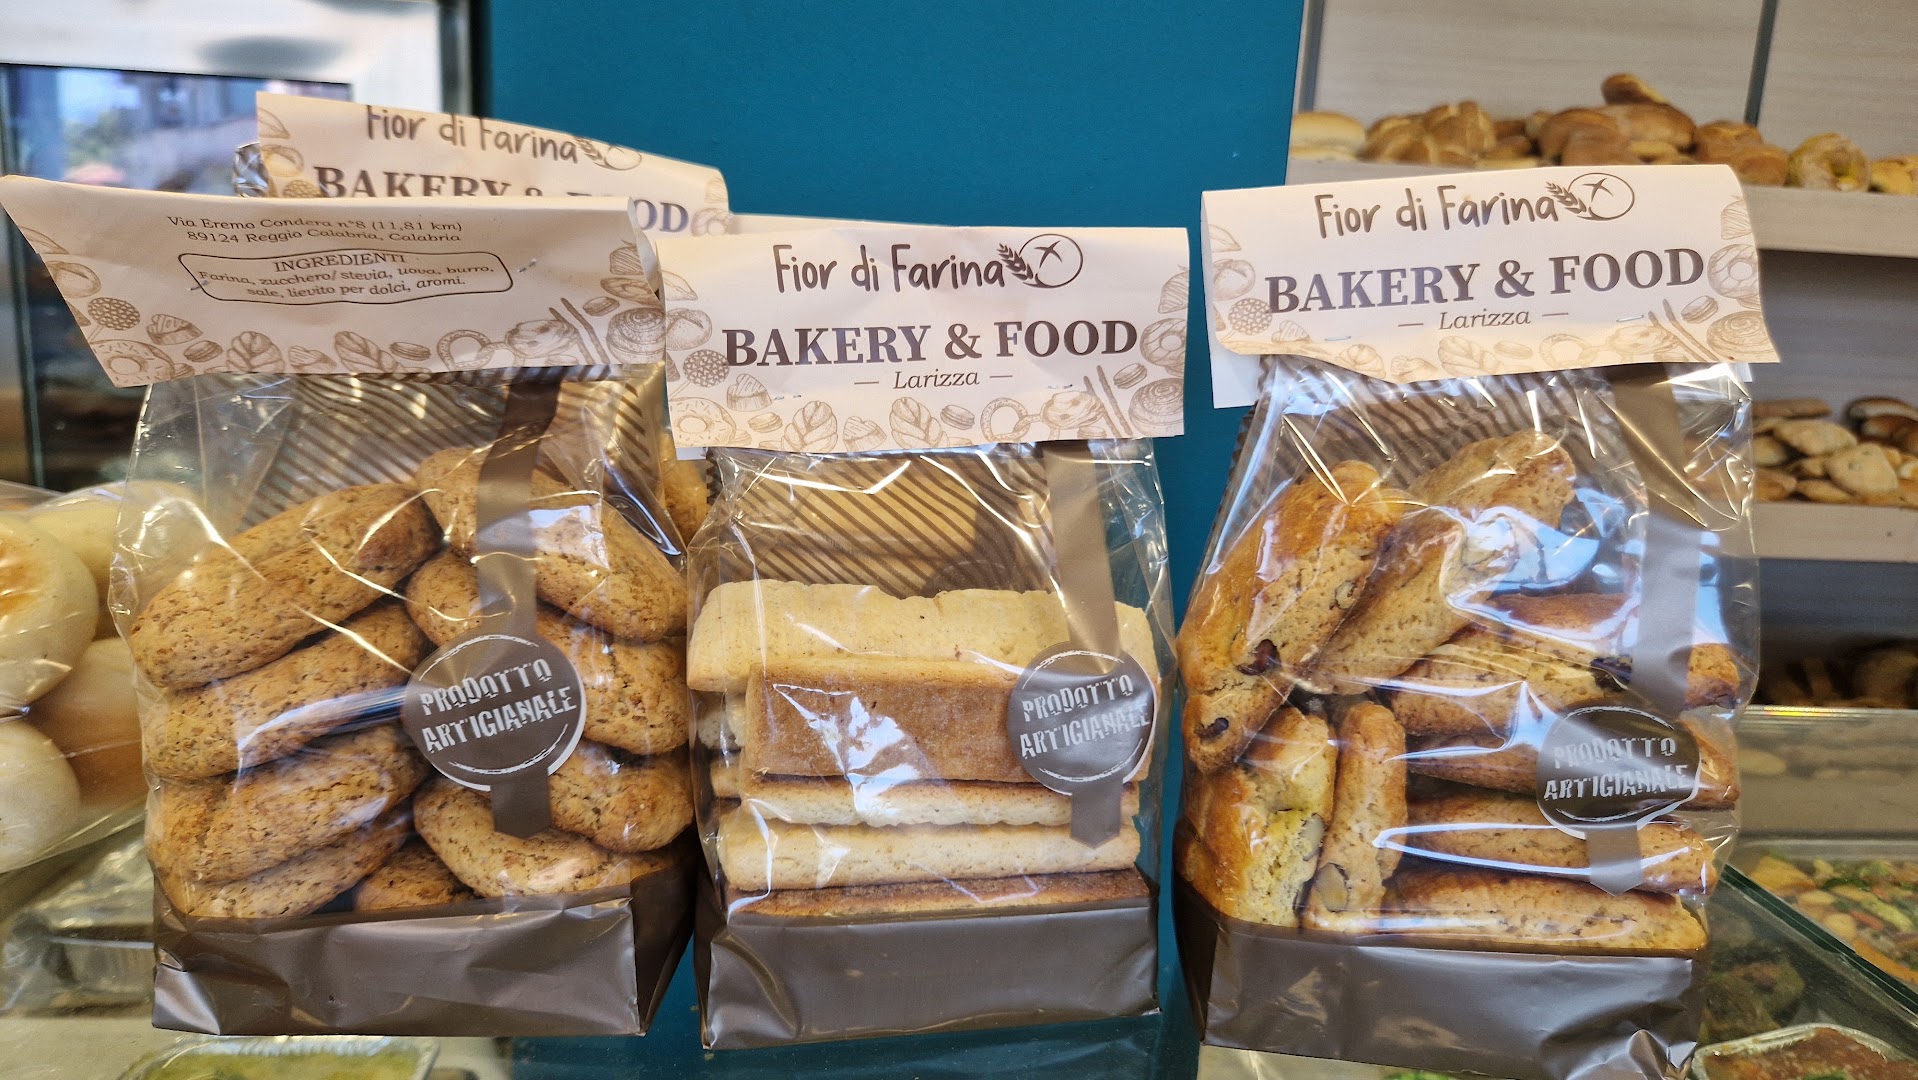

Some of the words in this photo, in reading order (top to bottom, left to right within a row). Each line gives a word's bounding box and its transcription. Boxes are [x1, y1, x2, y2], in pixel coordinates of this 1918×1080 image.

[367, 105, 426, 140] Fior
[439, 109, 466, 147] di
[478, 116, 578, 164] Farina
[168, 216, 195, 228] Via
[201, 218, 256, 229] Eremo
[260, 217, 333, 229] Condera
[337, 220, 366, 230] n°8
[372, 221, 423, 232] (11,81
[431, 222, 462, 232] km)
[1315, 193, 1381, 239] Fior
[1395, 186, 1428, 232] di
[1440, 184, 1559, 231] Farina
[187, 231, 239, 243] 89124
[246, 230, 302, 243] Reggio
[308, 228, 384, 241] Calabria,
[389, 233, 461, 242] Calabria
[199, 271, 256, 286] Farina,
[259, 269, 337, 286] zucchero/
[341, 269, 392, 281] stevia,
[399, 267, 441, 276] uova,
[447, 266, 494, 275] burro,
[274, 253, 406, 273] INGREDIENTI
[773, 244, 837, 294] Fior
[851, 243, 880, 292] di
[892, 244, 1006, 291] Farina
[1264, 262, 1482, 314] BAKERY
[1494, 258, 1535, 298] &
[1549, 247, 1705, 294] FOOD
[247, 287, 284, 299] sale,
[287, 286, 336, 298] lievito
[339, 285, 365, 296] per
[369, 281, 411, 295] dolci,
[416, 276, 465, 289] aromi.
[1438, 309, 1532, 330] Larizza
[722, 324, 931, 367] BAKERY
[944, 322, 983, 359] &
[995, 319, 1138, 357] FOOD
[893, 369, 981, 390] Larizza
[419, 658, 553, 716] PRODOTTO
[1022, 674, 1134, 722] PRODOTTO
[421, 686, 577, 754] ARTIGIANALE
[1019, 702, 1151, 759] ARTIGIANALE
[1553, 737, 1676, 769] PRODOTTO
[1543, 764, 1691, 801] ARTIGIANALE
